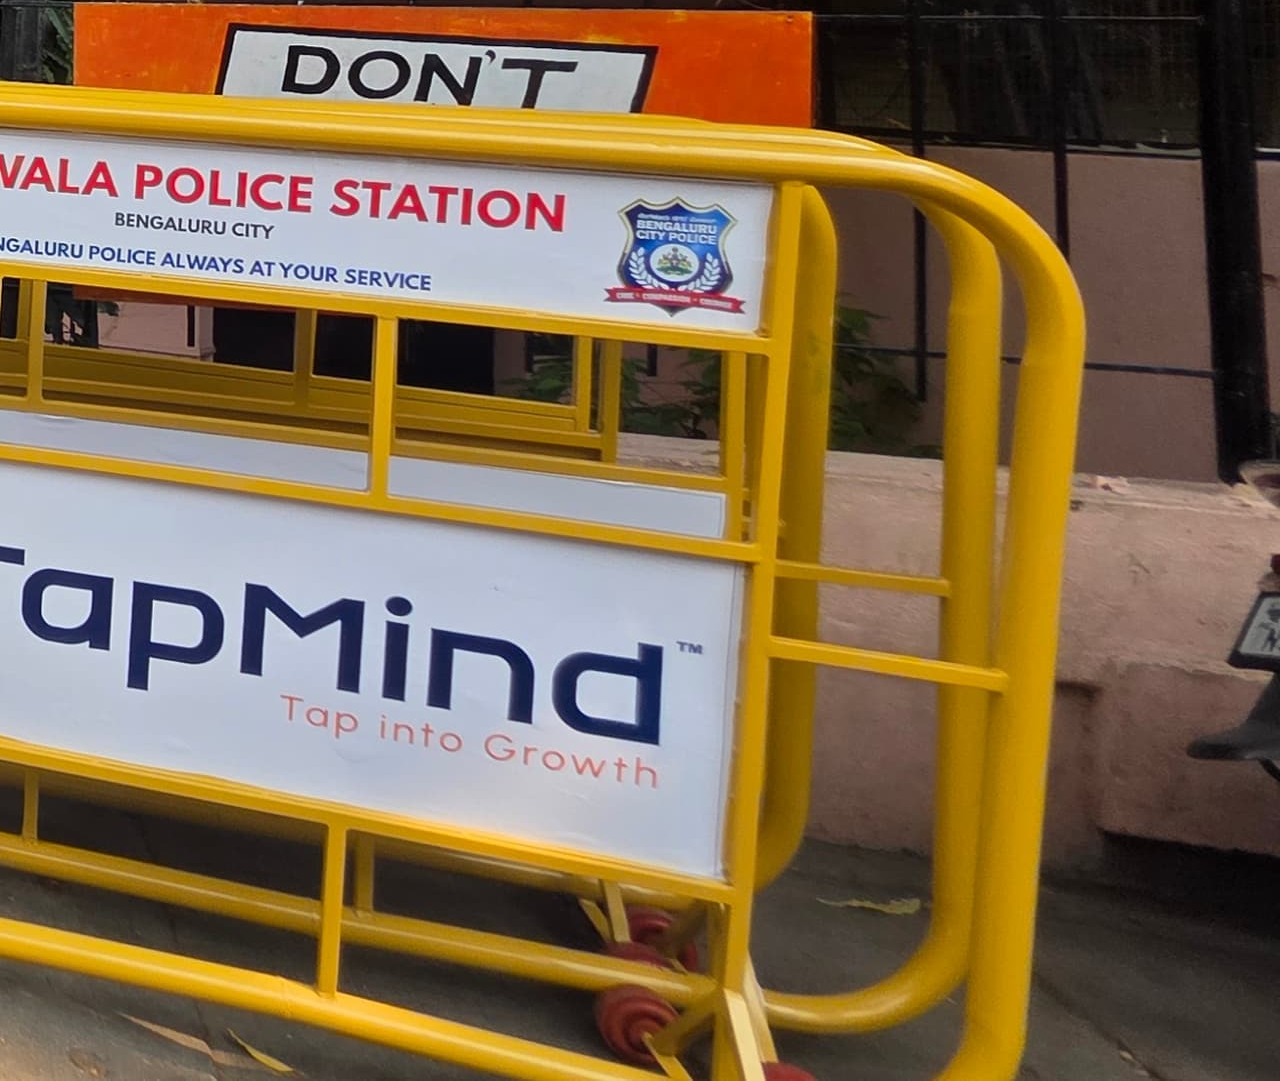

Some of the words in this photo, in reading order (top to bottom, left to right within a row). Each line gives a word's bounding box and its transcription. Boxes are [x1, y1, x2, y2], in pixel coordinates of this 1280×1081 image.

[281, 45, 579, 109] DON'T
[134, 163, 314, 214] POLICE
[329, 178, 567, 233] STATION
[114, 211, 227, 237] BENGALURU
[231, 220, 275, 241] CITY
[636, 220, 718, 235] BENGALURU
[636, 230, 665, 241] CITY
[668, 232, 717, 246] POLICE
[88, 244, 156, 266] POLICE
[161, 251, 244, 275] ALWAYS
[249, 259, 278, 277] AT
[278, 262, 339, 285] YOUR
[344, 267, 432, 292] SERVICE
[280, 693, 360, 739] Tap
[380, 713, 463, 754] into
[483, 734, 659, 791] Growth
